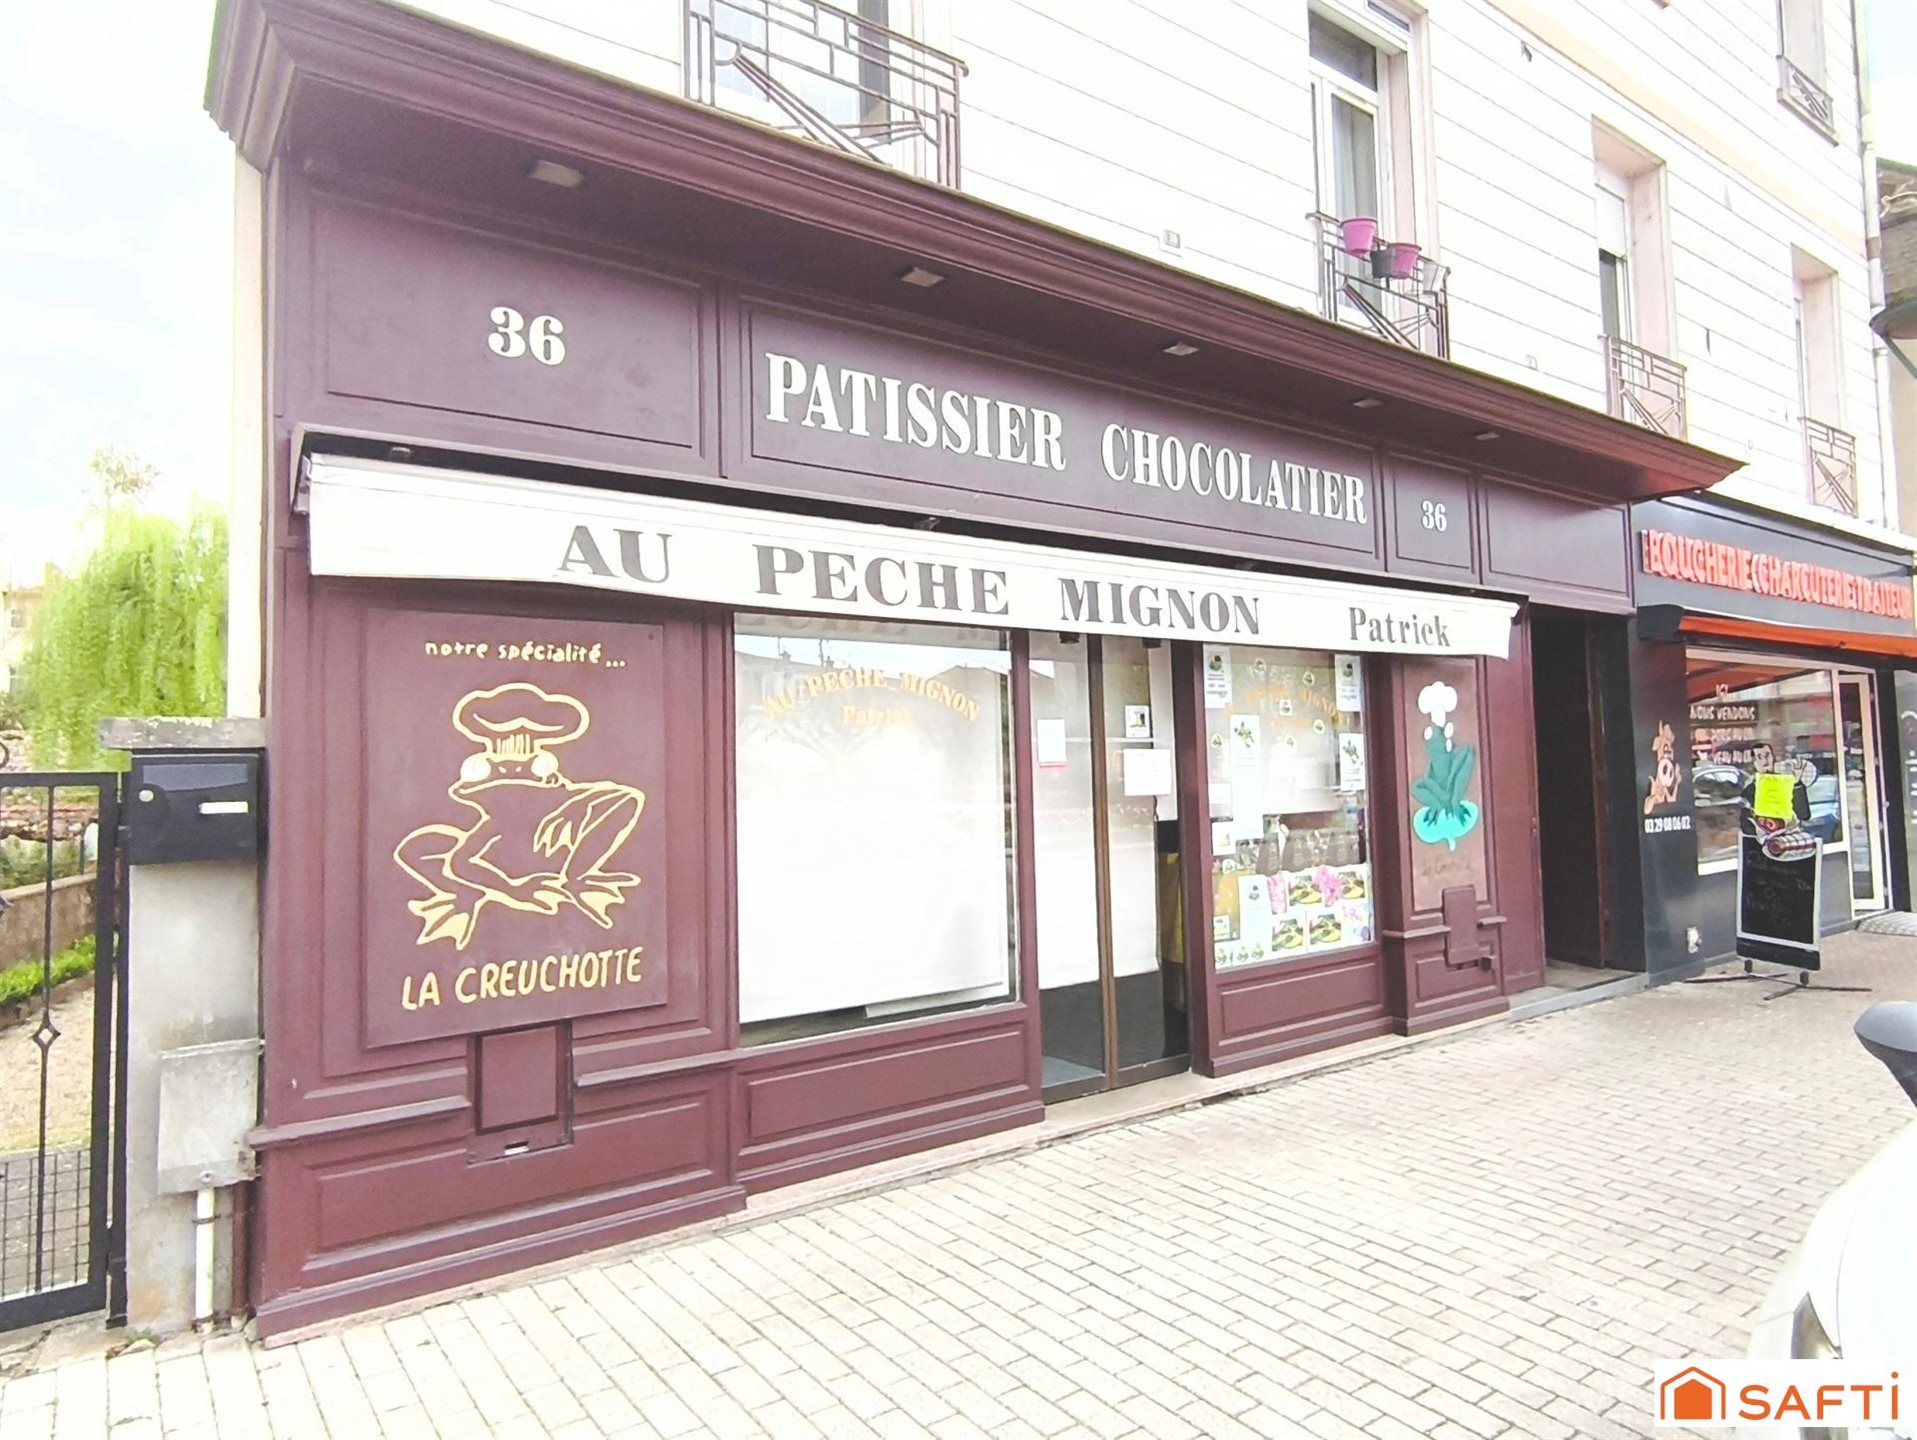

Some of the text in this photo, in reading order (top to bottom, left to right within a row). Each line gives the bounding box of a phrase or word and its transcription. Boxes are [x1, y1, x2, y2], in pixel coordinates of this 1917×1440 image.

[488, 306, 566, 366] 36
[765, 352, 1368, 525] PATISSIER CHOCOLATIER
[1421, 500, 1448, 532] 36
[557, 524, 672, 584] AU
[752, 543, 1010, 616] PECHE
[1057, 577, 1260, 636] MIGNON
[1642, 529, 1752, 592] BOUCHERIE
[425, 641, 489, 659] notre
[1348, 606, 1452, 648] Patrick
[804, 667, 888, 698] PECHE
[898, 672, 981, 722] MIGNON
[402, 946, 644, 1010] LA CREUCHOTTE
